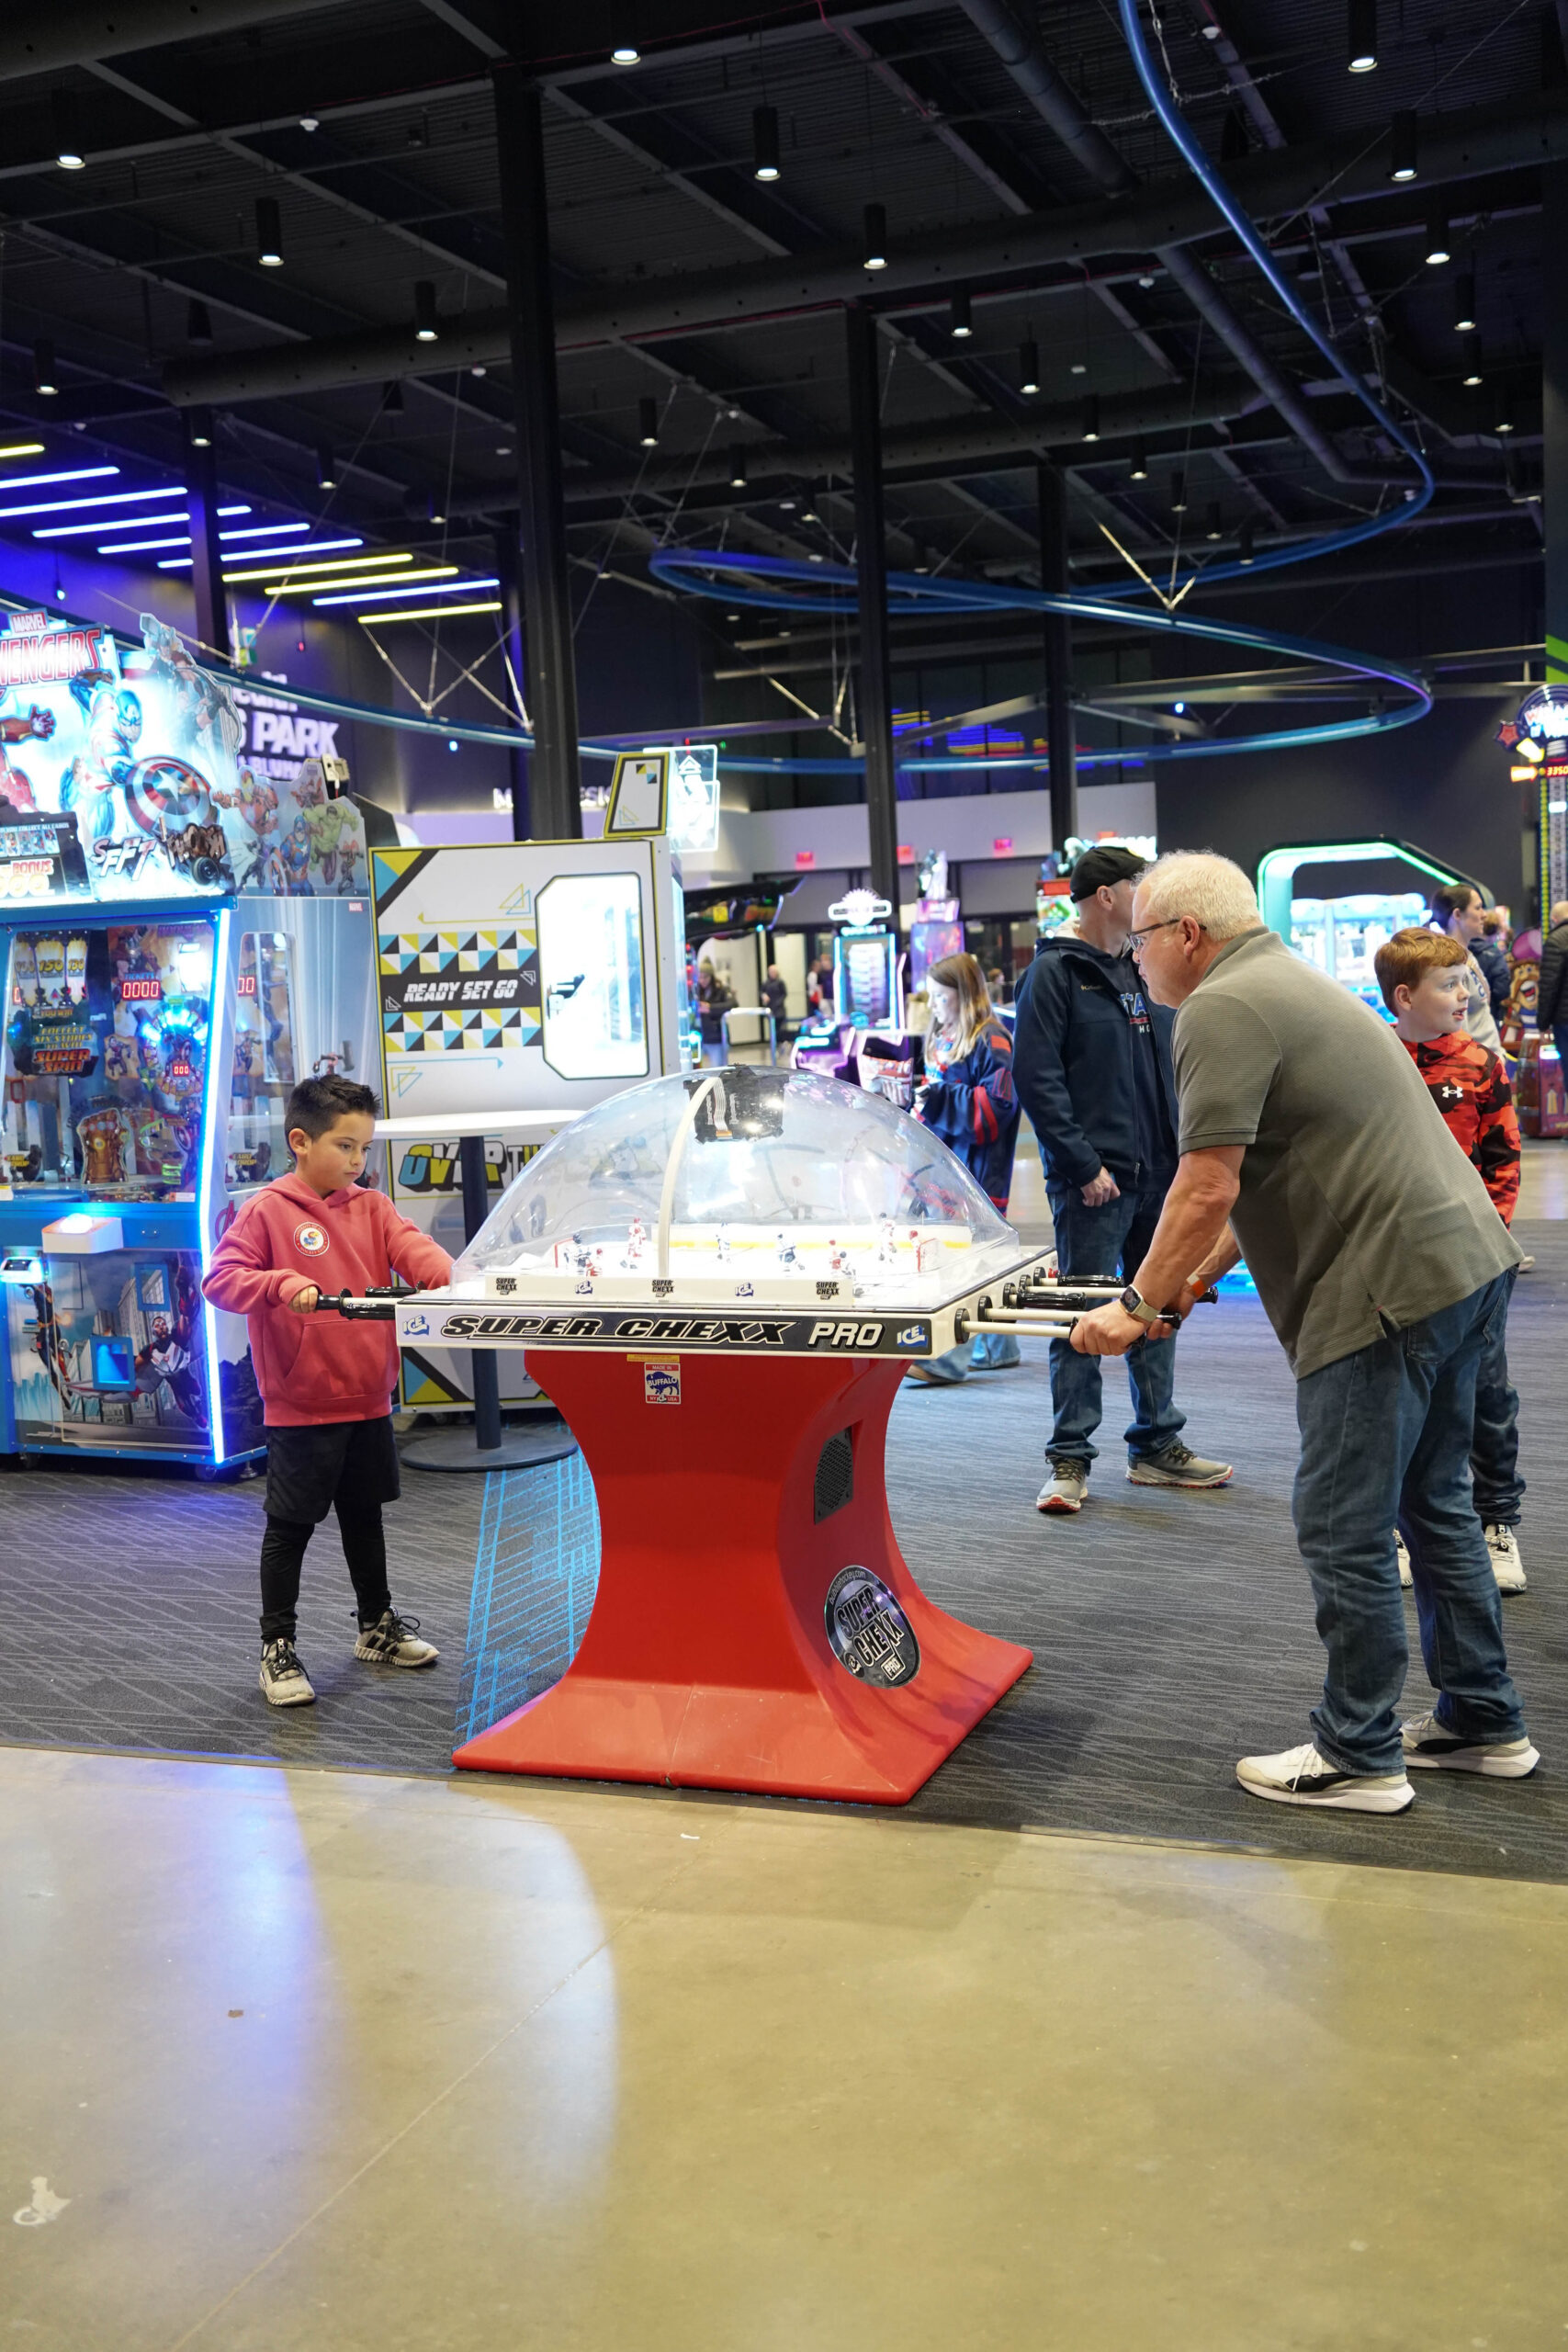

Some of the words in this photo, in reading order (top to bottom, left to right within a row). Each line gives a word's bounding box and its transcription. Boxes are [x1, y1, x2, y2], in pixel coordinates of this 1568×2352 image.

[12, 612, 47, 633] MARVEL
[252, 710, 339, 760] PARK
[12, 860, 52, 874] BONUS
[38, 959, 64, 971] 150
[124, 972, 154, 980] TICKETS
[122, 981, 160, 999] 0000
[403, 981, 460, 1002] READY
[461, 979, 493, 1000] SET
[493, 979, 518, 999] GO
[34, 1049, 90, 1062] SUPER
[42, 1061, 82, 1073] SPIN
[174, 1066, 189, 1075] 000
[402, 1315, 429, 1335] ICE
[441, 1315, 603, 1338] SUPER
[615, 1318, 798, 1344] CHEXX
[807, 1322, 886, 1349] PRO
[897, 1325, 928, 1347] ICE
[648, 1377, 677, 1385] BUFFALO
[837, 1586, 881, 1639] SUPER
[853, 1609, 905, 1667] CHEXX
[886, 1657, 902, 1677] PRO
